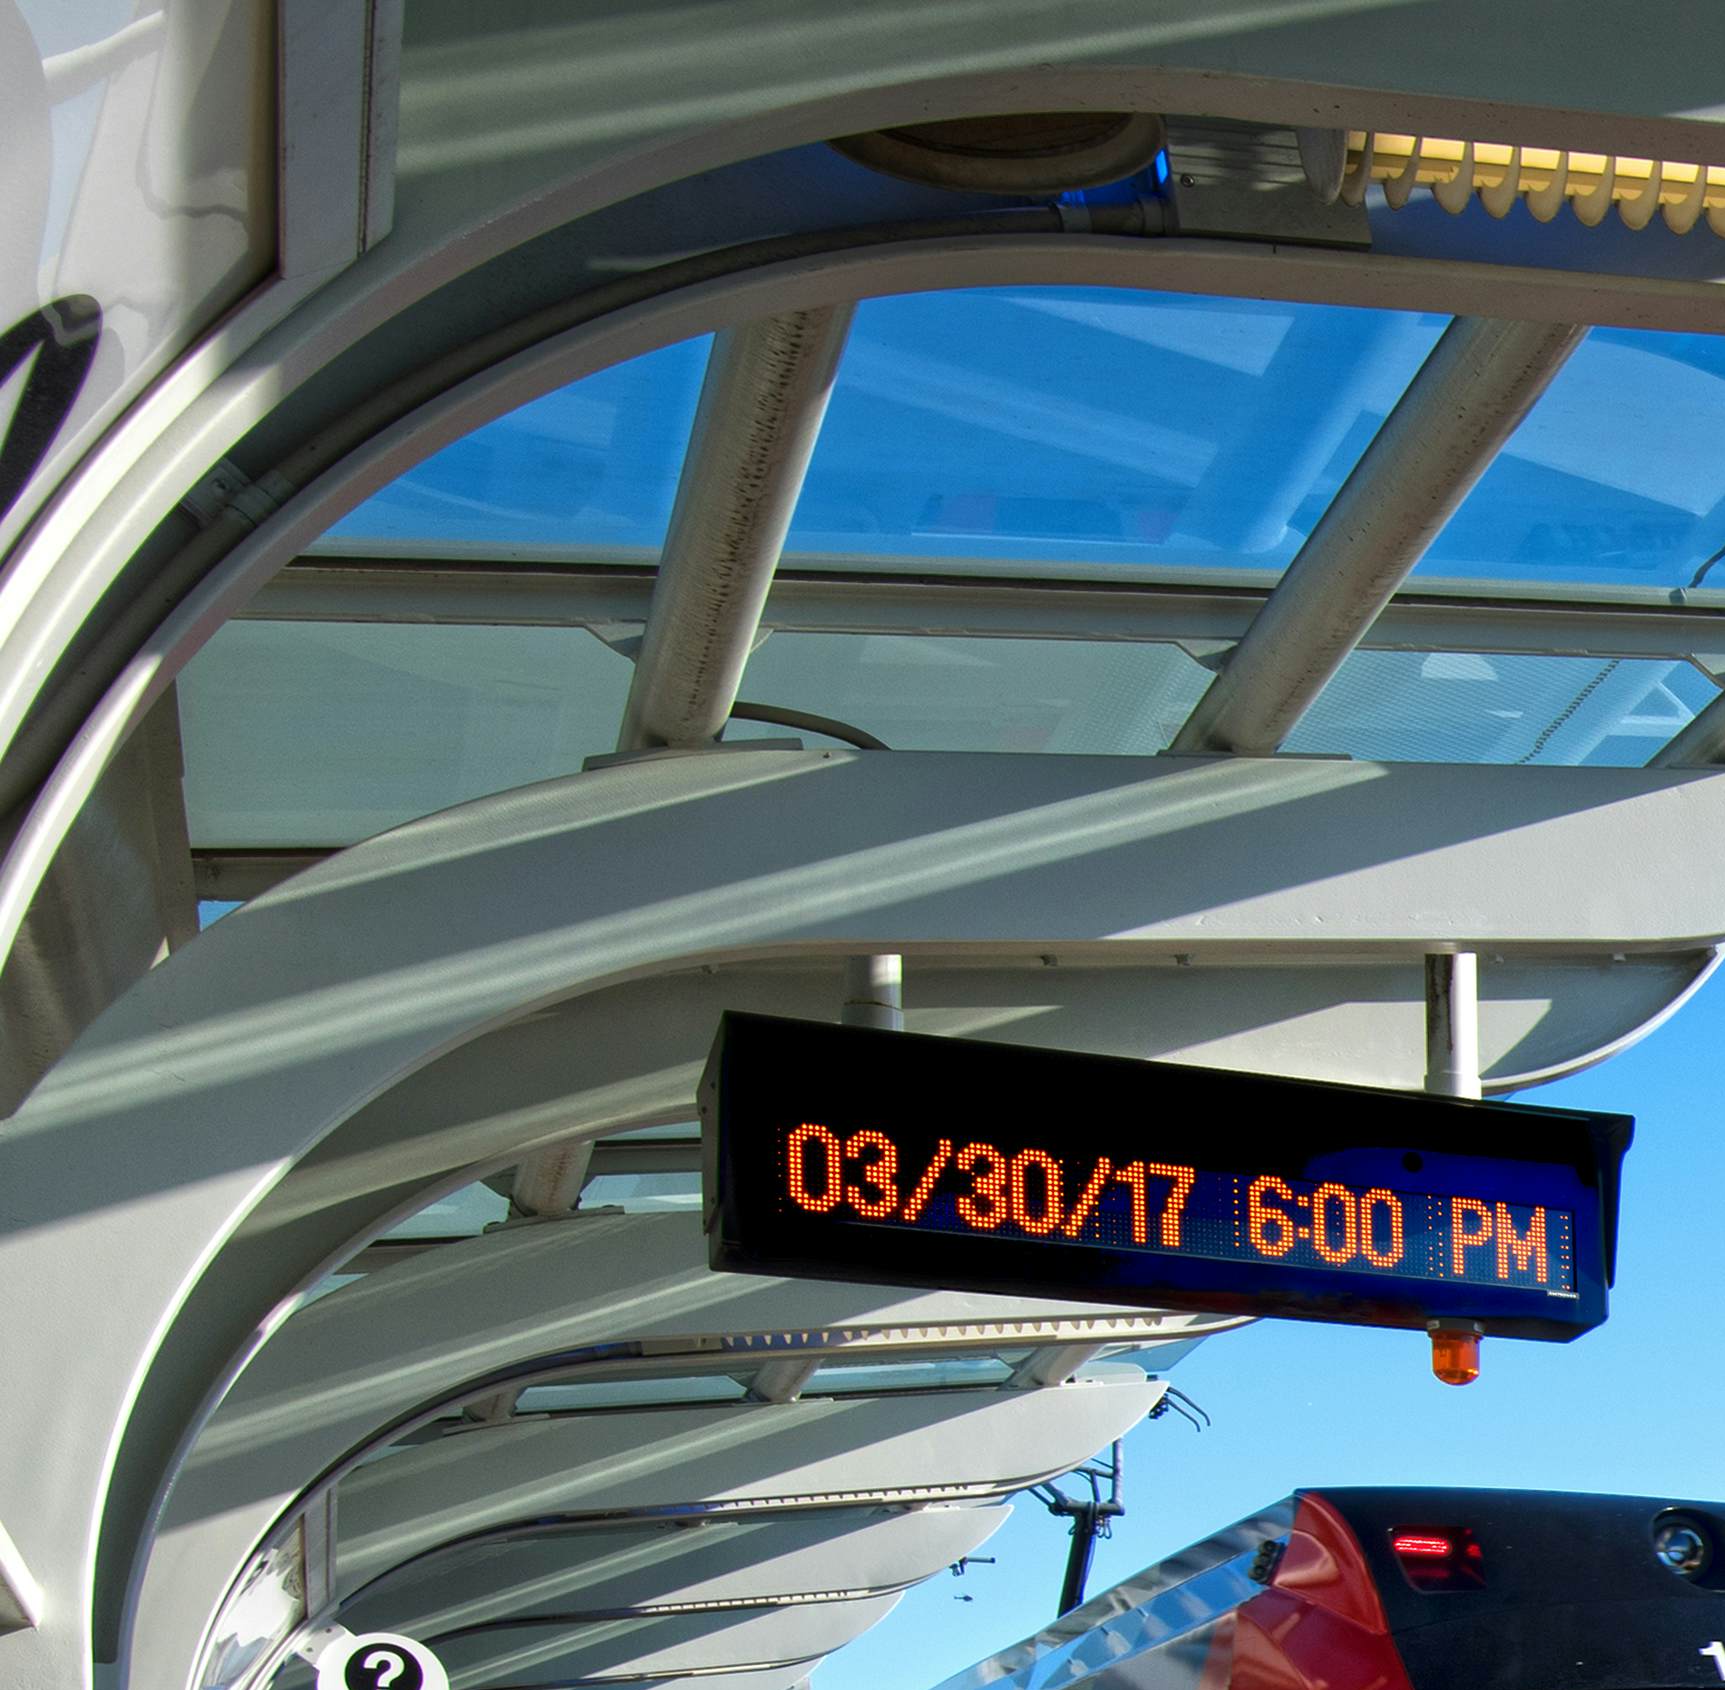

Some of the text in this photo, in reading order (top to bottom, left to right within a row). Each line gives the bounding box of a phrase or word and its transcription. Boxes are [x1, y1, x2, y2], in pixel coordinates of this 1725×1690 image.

[787, 1122, 1548, 1285] 03/30/17 6:00 PM
